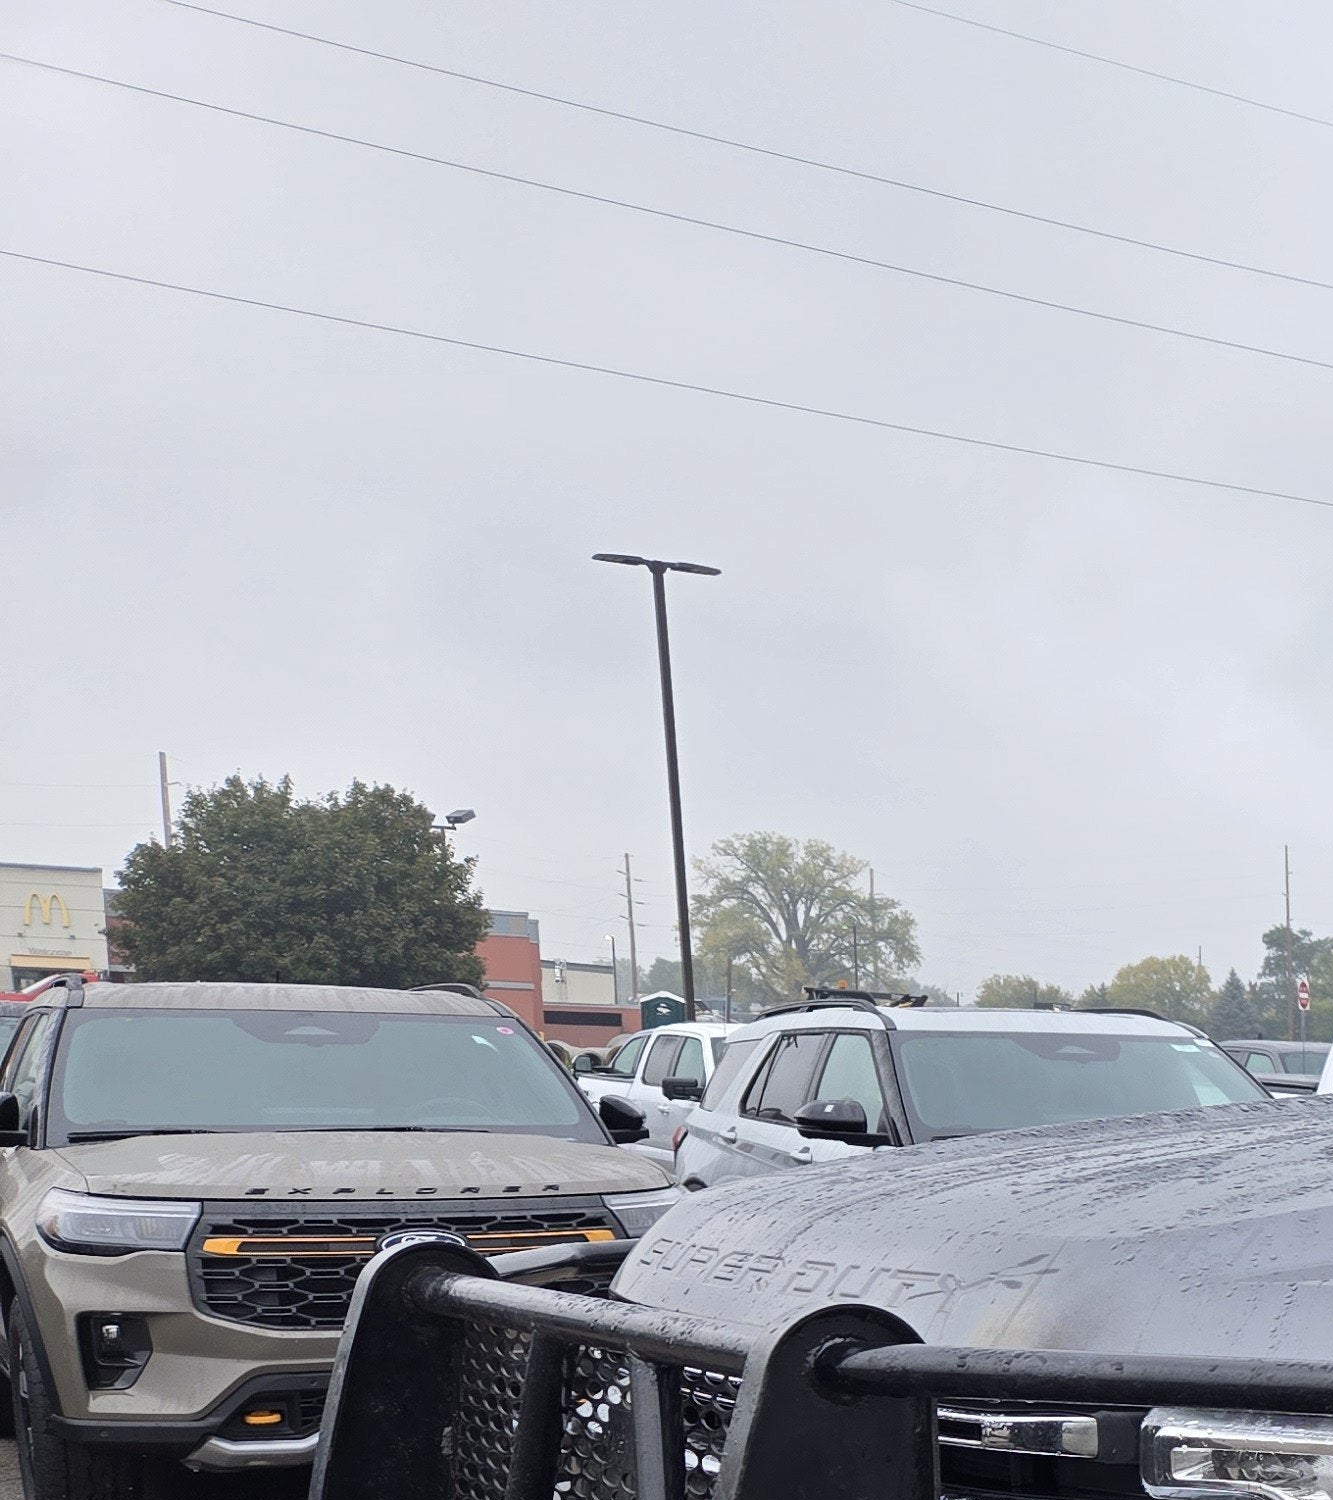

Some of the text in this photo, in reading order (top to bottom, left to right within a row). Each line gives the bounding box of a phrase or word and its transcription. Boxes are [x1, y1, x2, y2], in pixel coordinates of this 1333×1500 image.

[244, 1184, 561, 1196] EXPLORER
[638, 1238, 996, 1314] SUPER DUTY
